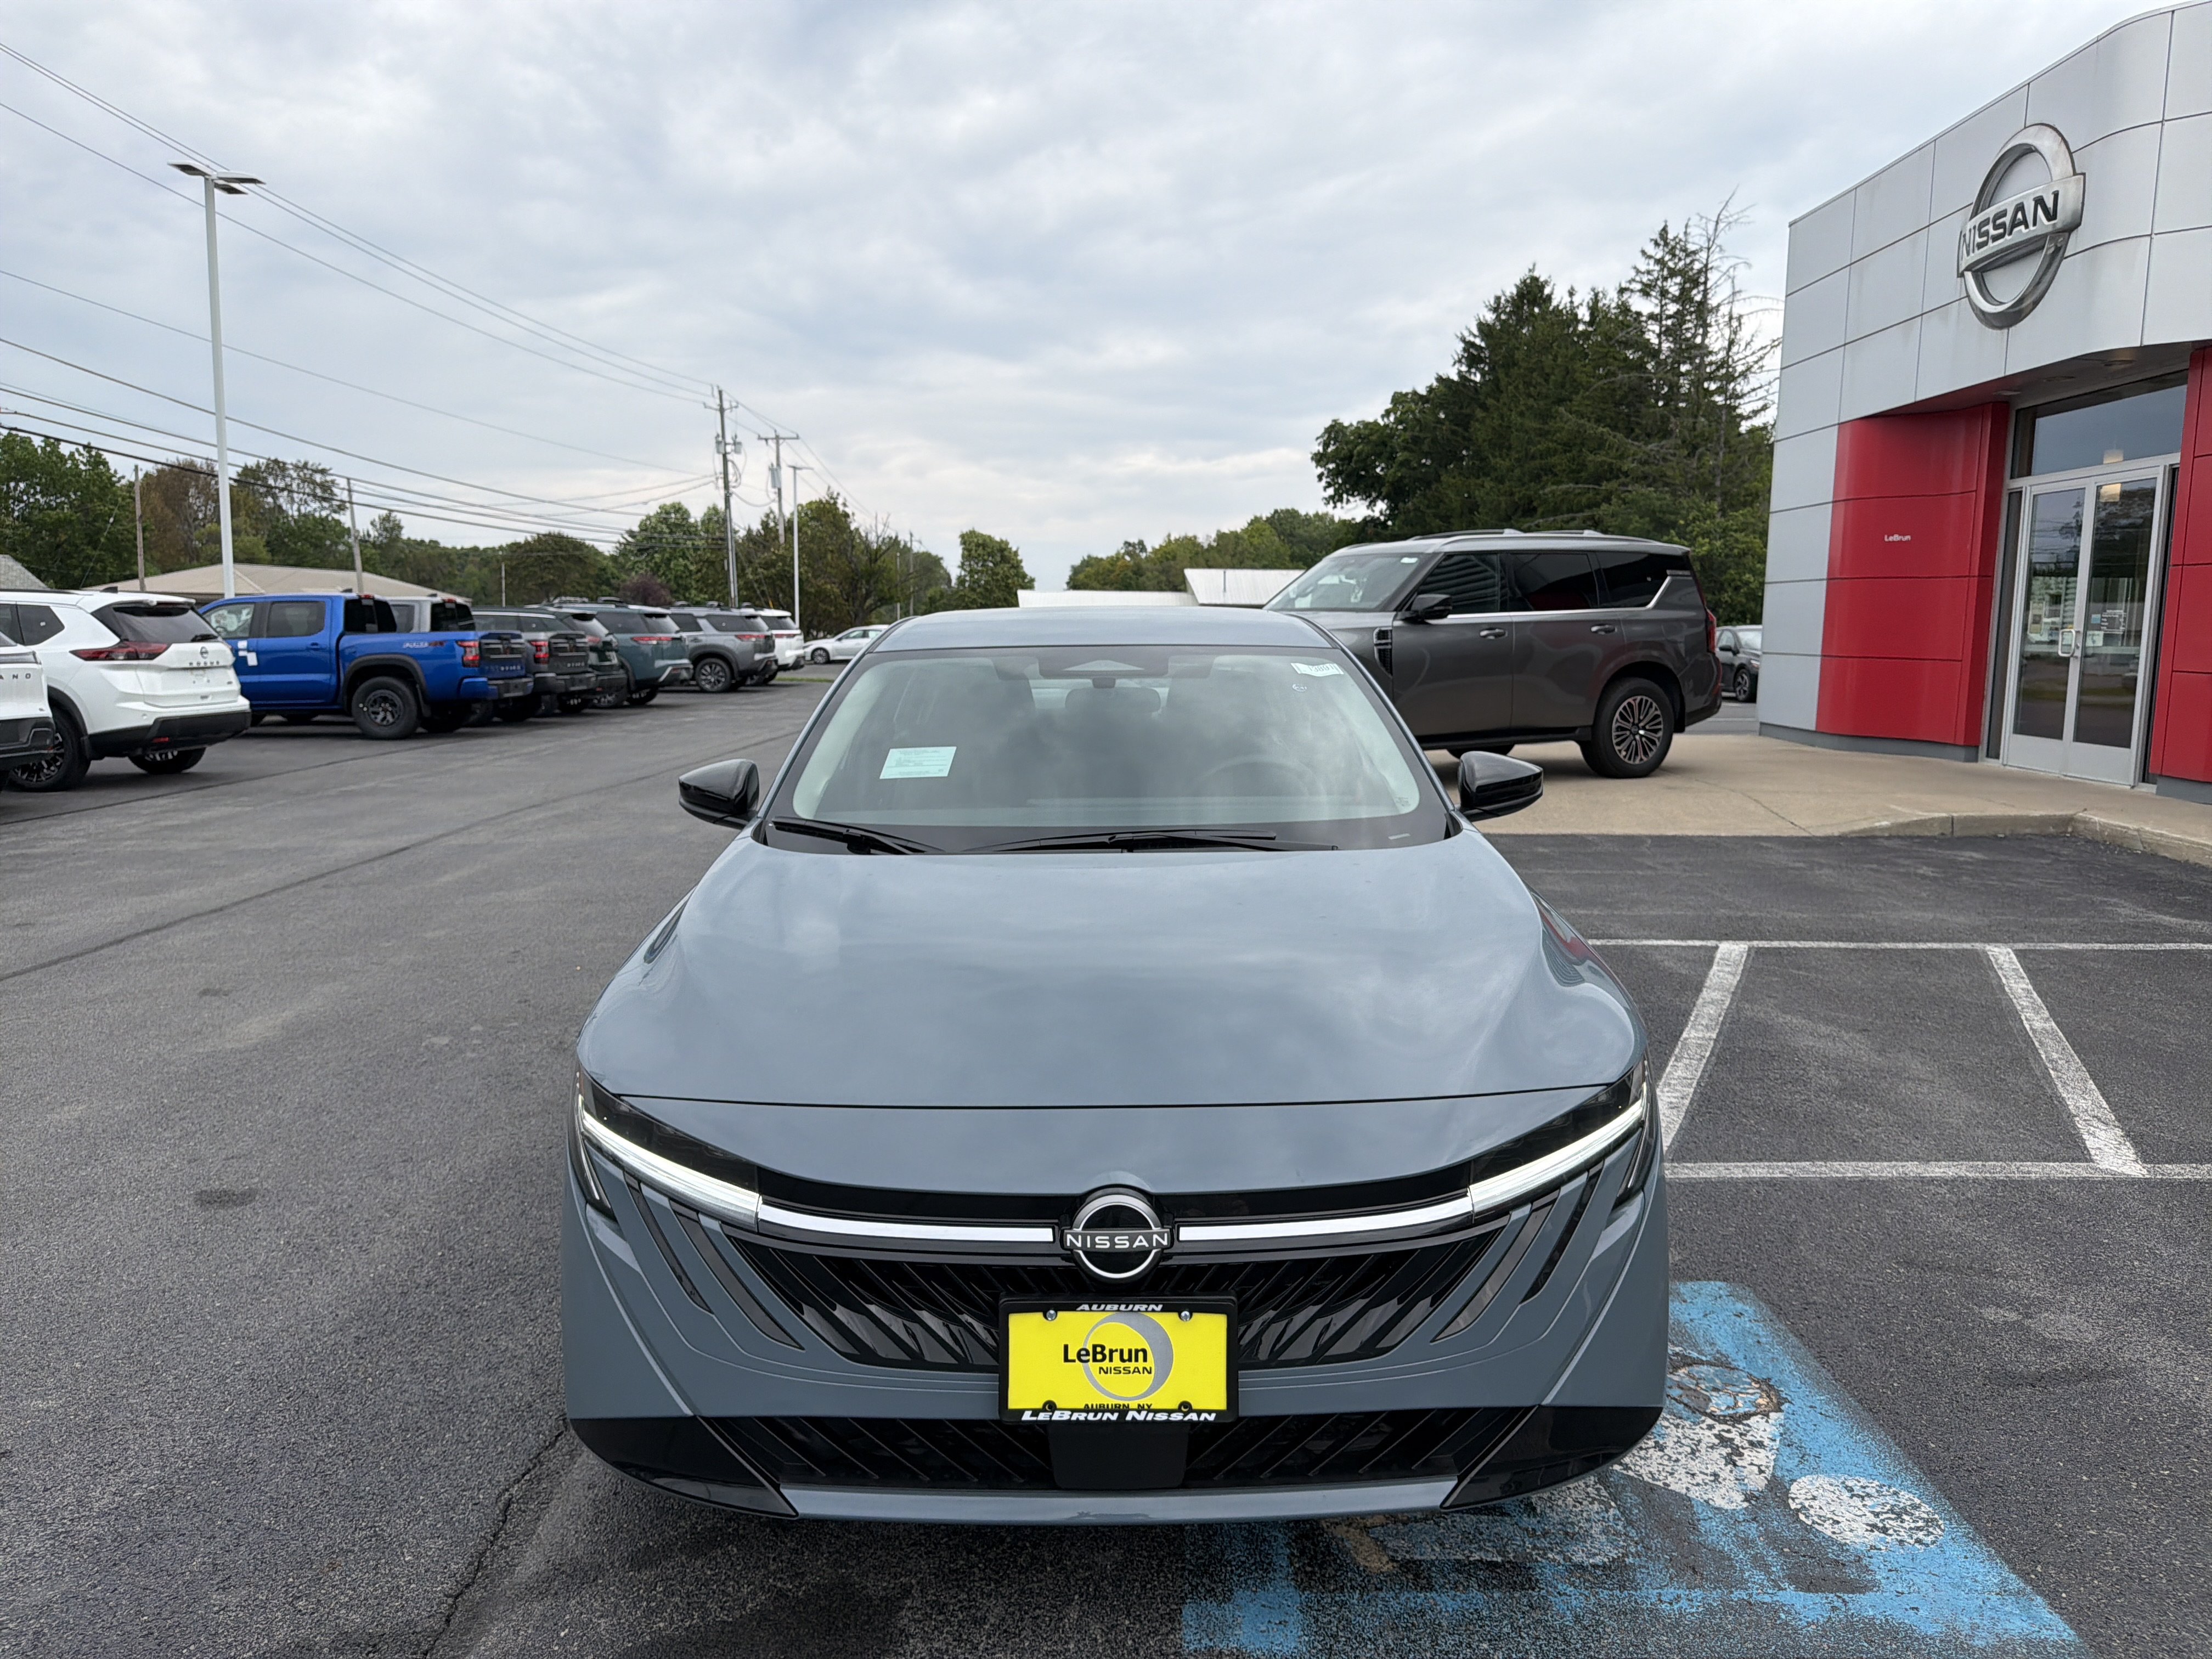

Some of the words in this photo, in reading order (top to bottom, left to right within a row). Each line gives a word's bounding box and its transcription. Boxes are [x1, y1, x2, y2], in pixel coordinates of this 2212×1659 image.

[1961, 190, 2059, 261] NISSAN
[1884, 534, 1911, 542] LeBrun
[1066, 1233, 1168, 1249] NISSAN
[1076, 1304, 1164, 1312] AUBURN
[1063, 1344, 1148, 1363] LeBrun
[1098, 1366, 1152, 1375] NISSAN
